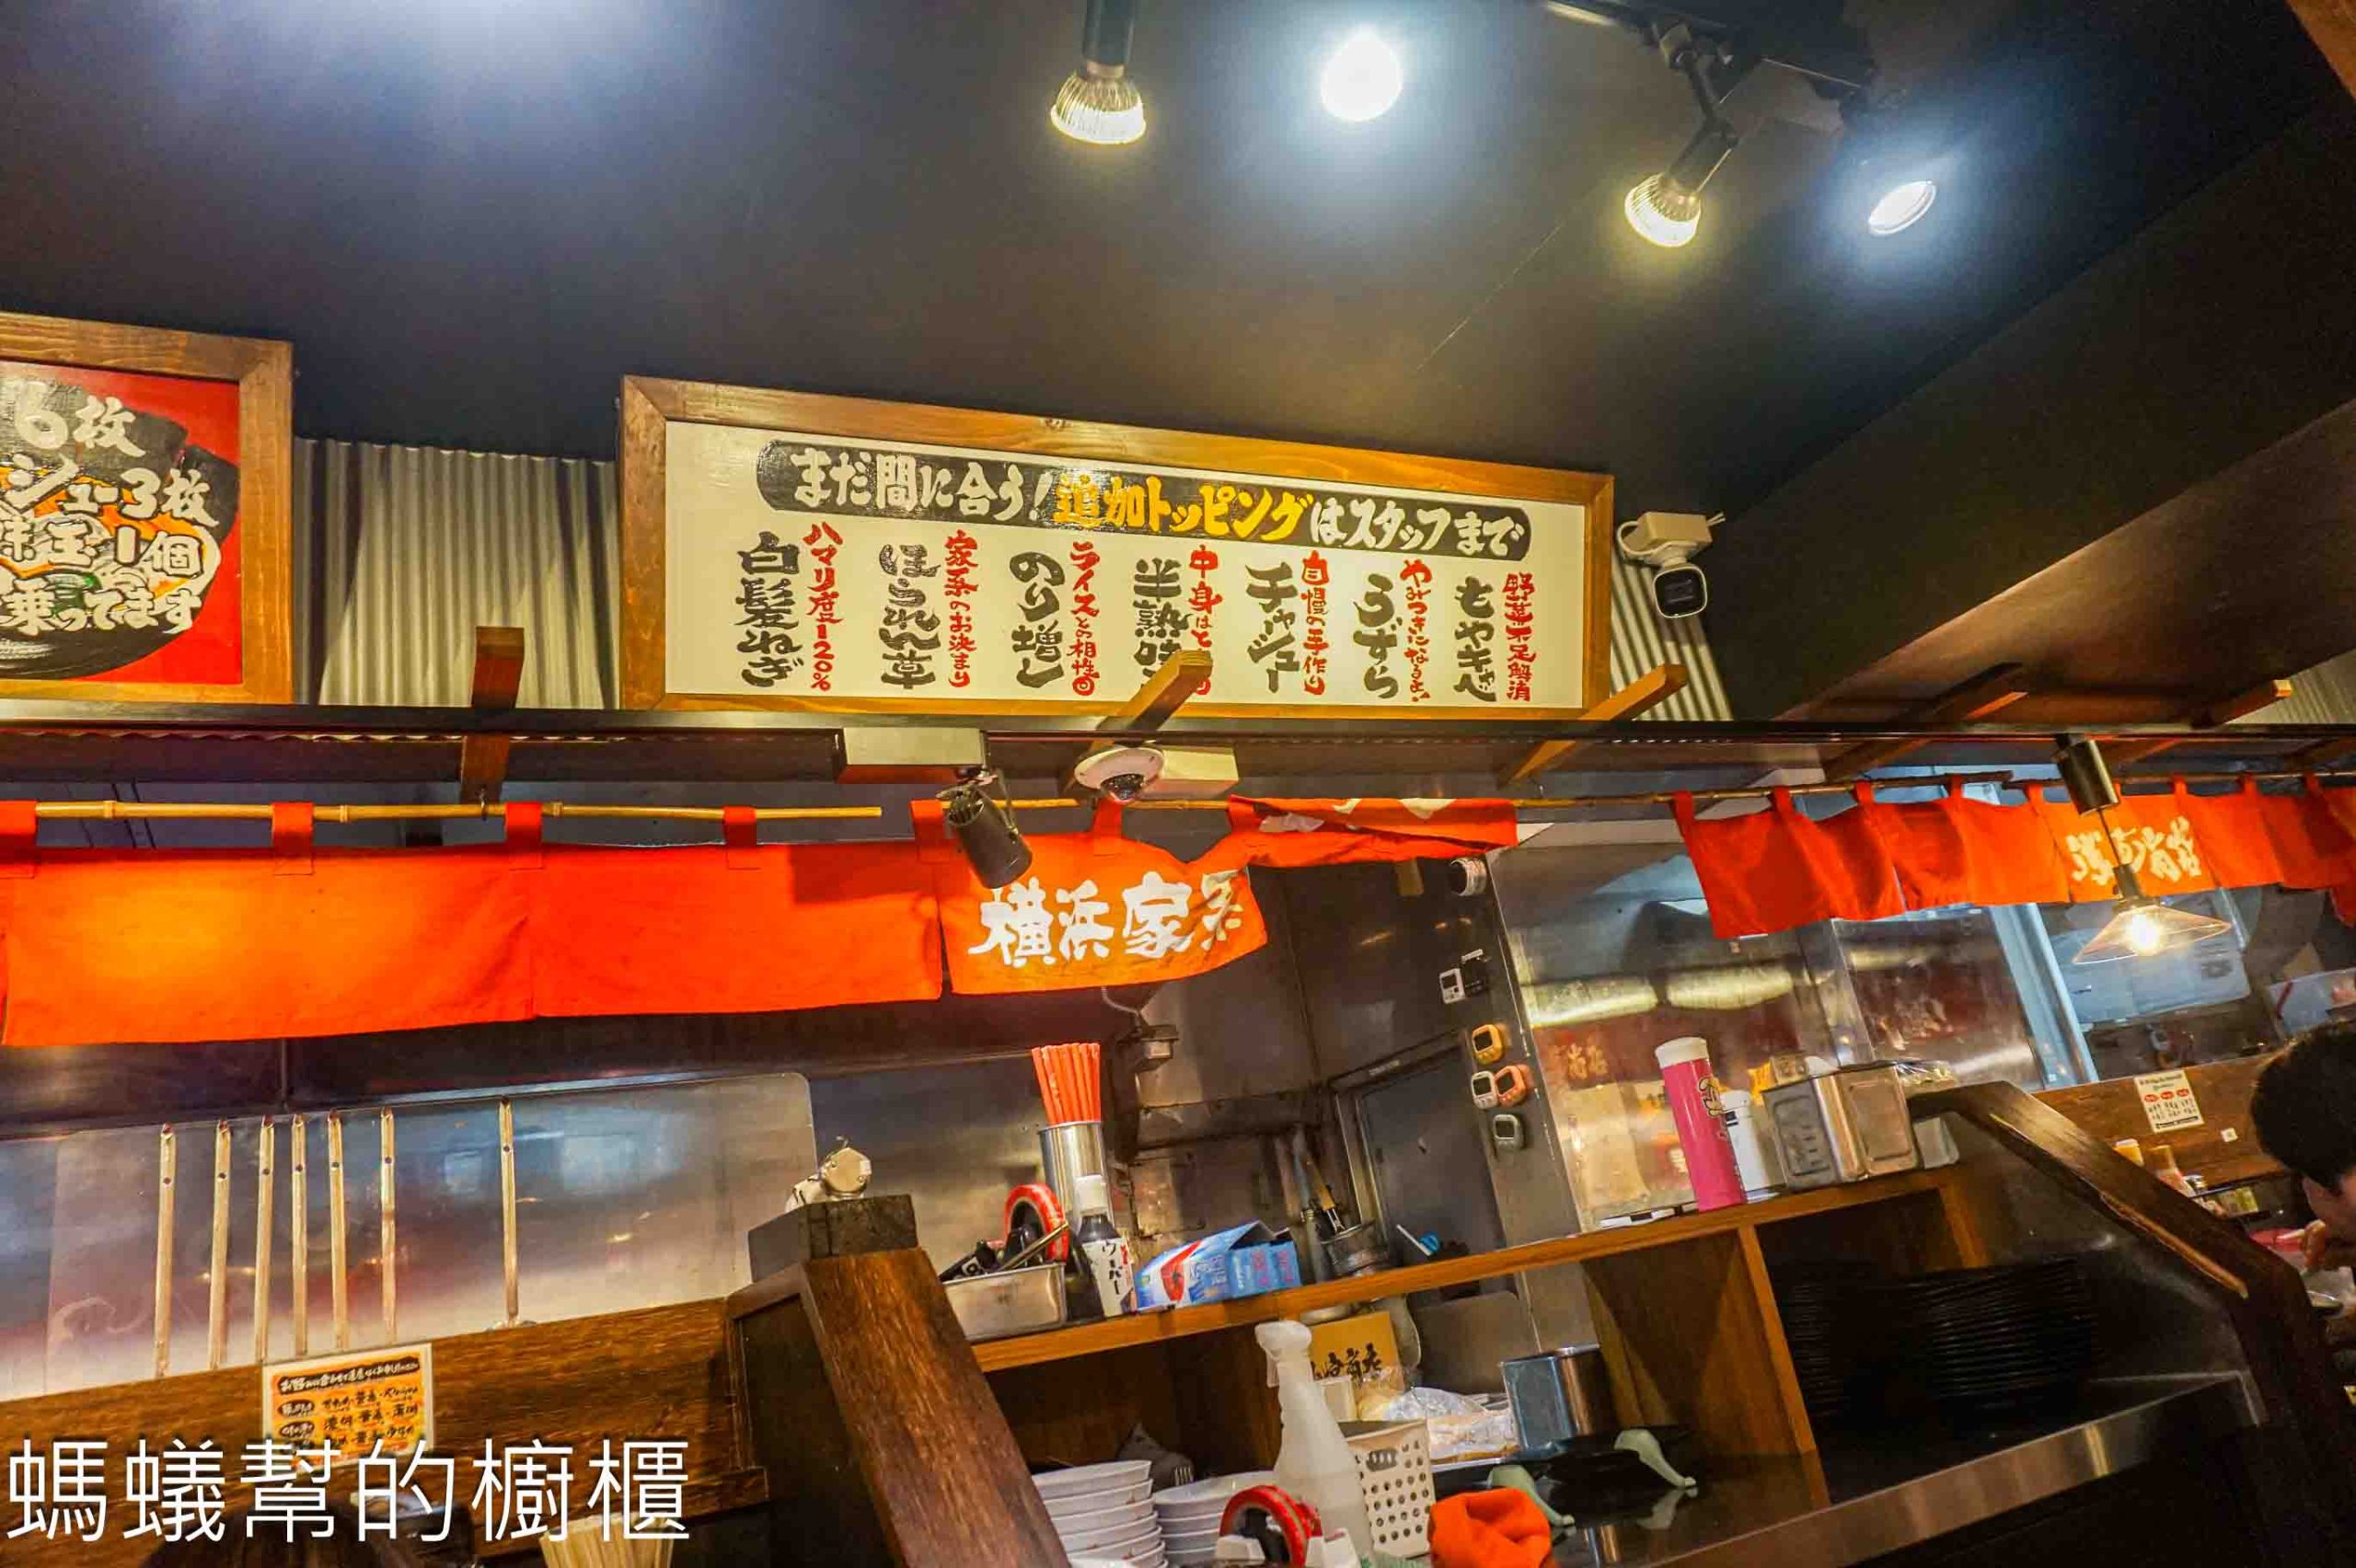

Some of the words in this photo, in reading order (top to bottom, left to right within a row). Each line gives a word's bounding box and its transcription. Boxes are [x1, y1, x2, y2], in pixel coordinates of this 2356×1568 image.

[734, 530, 805, 688] 白髪ねぎ
[878, 543, 941, 690] ほうれん草
[944, 529, 979, 688] 家系のお決まり
[1009, 551, 1066, 689] のり増し
[1244, 561, 1300, 694] チャーシュー
[1300, 549, 1330, 696] 自慢の手作り
[1352, 572, 1403, 699] うずら
[1452, 575, 1497, 703] もやキャベ
[1502, 571, 1537, 702] 野菜不足解消
